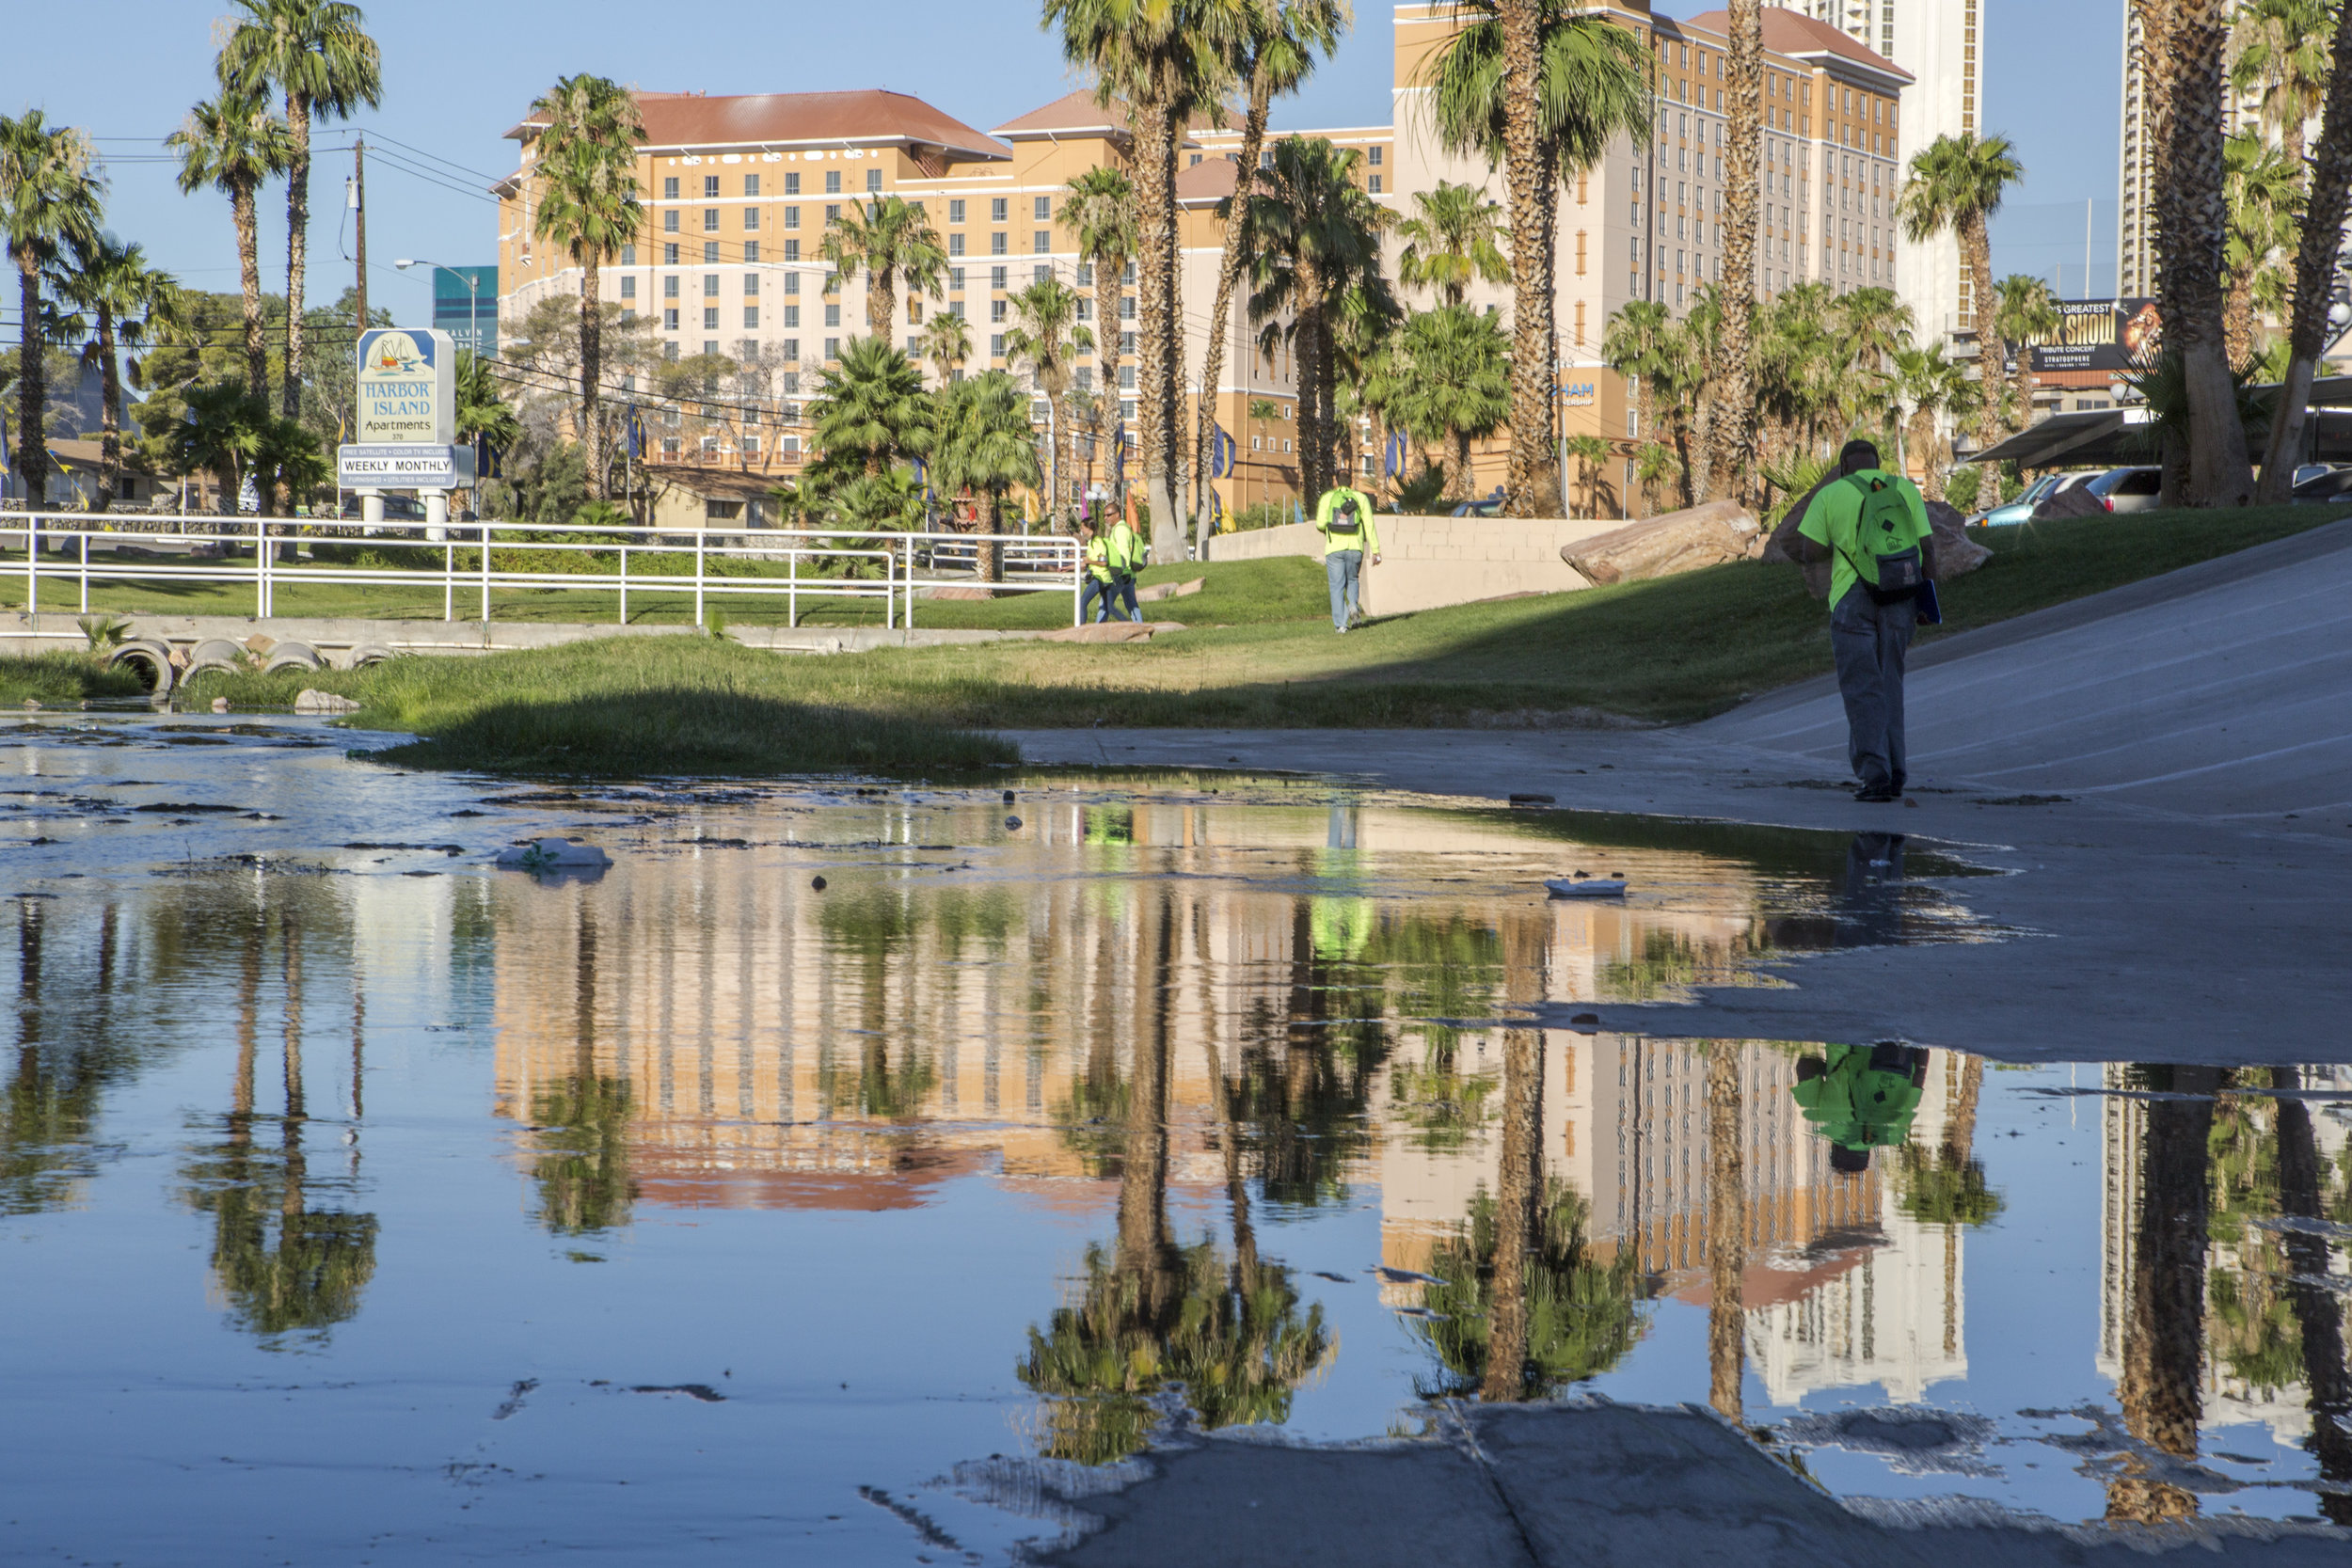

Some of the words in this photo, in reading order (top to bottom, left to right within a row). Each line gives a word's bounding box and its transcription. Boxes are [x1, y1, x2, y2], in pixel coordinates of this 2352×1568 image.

[2063, 304, 2110, 314] GREATEST
[2065, 305, 2116, 345] SHOW
[445, 329, 483, 338] ALVN
[2044, 355, 2090, 363] STRATOSPHERE
[365, 383, 430, 398] HARBOR
[373, 401, 431, 416] ISLAND
[365, 420, 432, 433] Apartments
[344, 461, 389, 471] WEEKLY
[395, 460, 450, 471] MONTHLY
